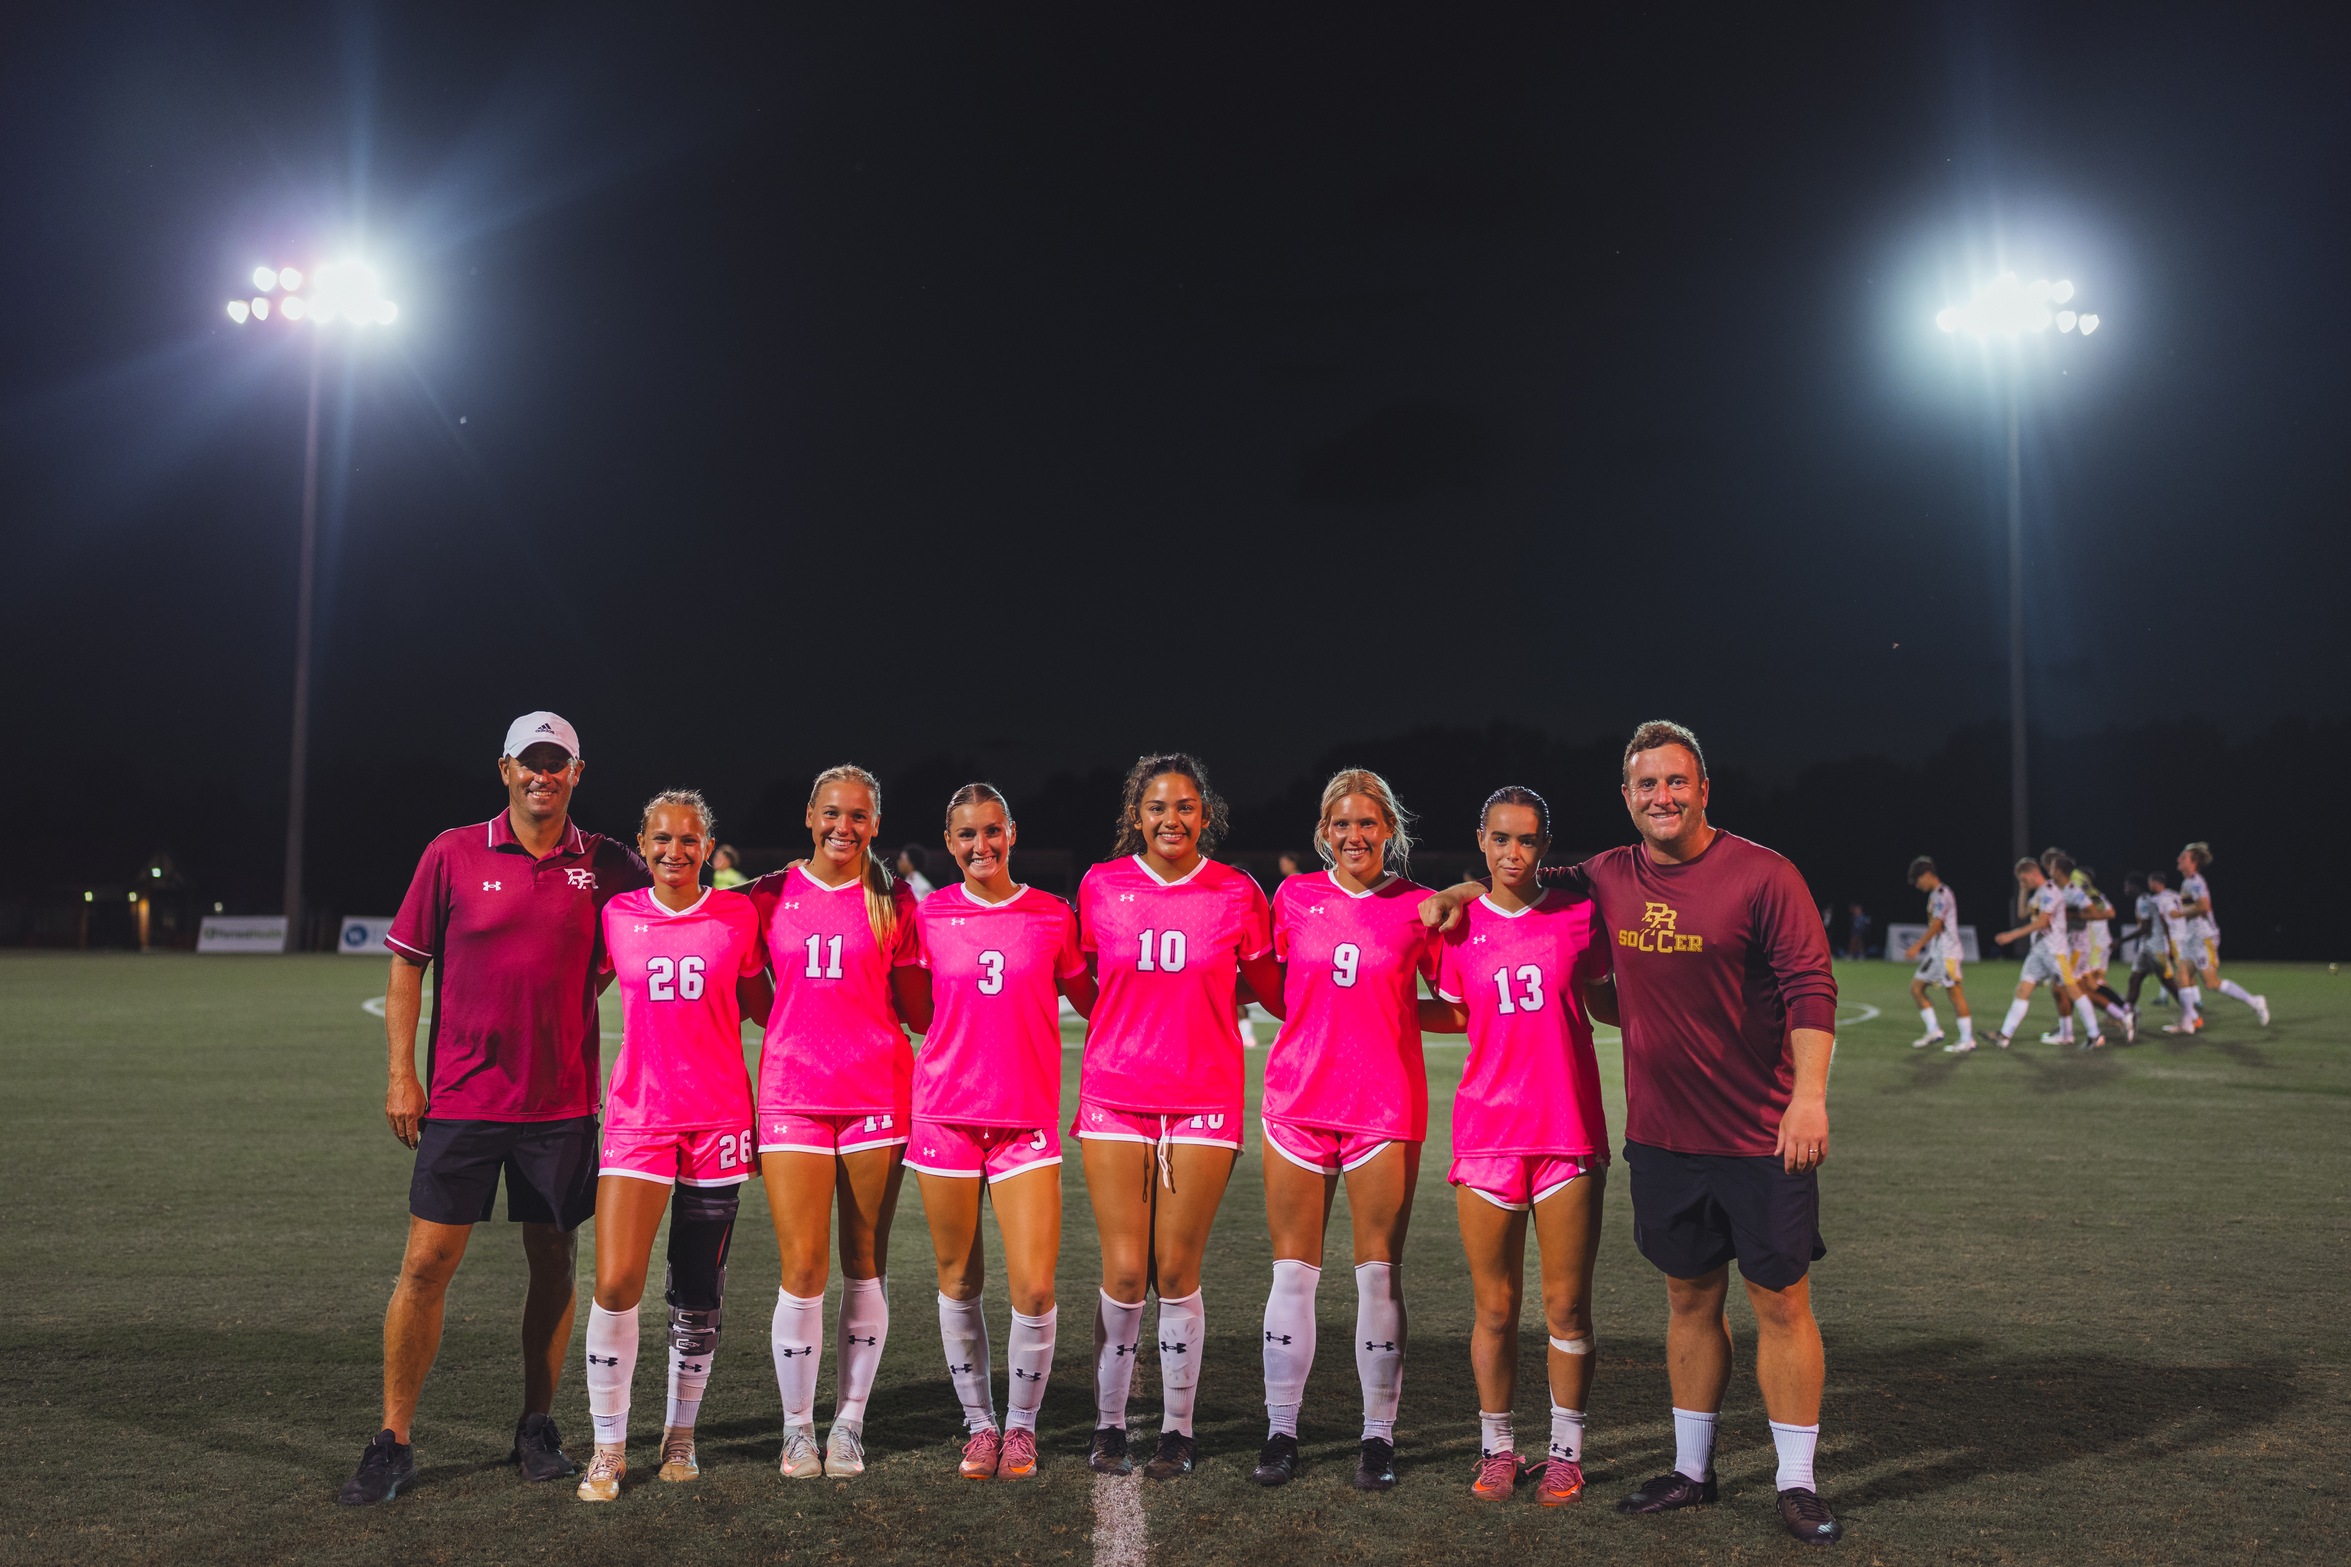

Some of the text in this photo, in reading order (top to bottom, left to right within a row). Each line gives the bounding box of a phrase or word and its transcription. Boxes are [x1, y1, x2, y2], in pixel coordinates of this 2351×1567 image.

[804, 933, 844, 980] 11
[1136, 928, 1187, 973] 10
[1618, 928, 1704, 953] SOCCER
[646, 955, 706, 1002] 26
[976, 949, 1005, 996] 3
[1331, 942, 1361, 988] 9
[1493, 963, 1545, 1015] 13
[719, 1128, 752, 1170] 26
